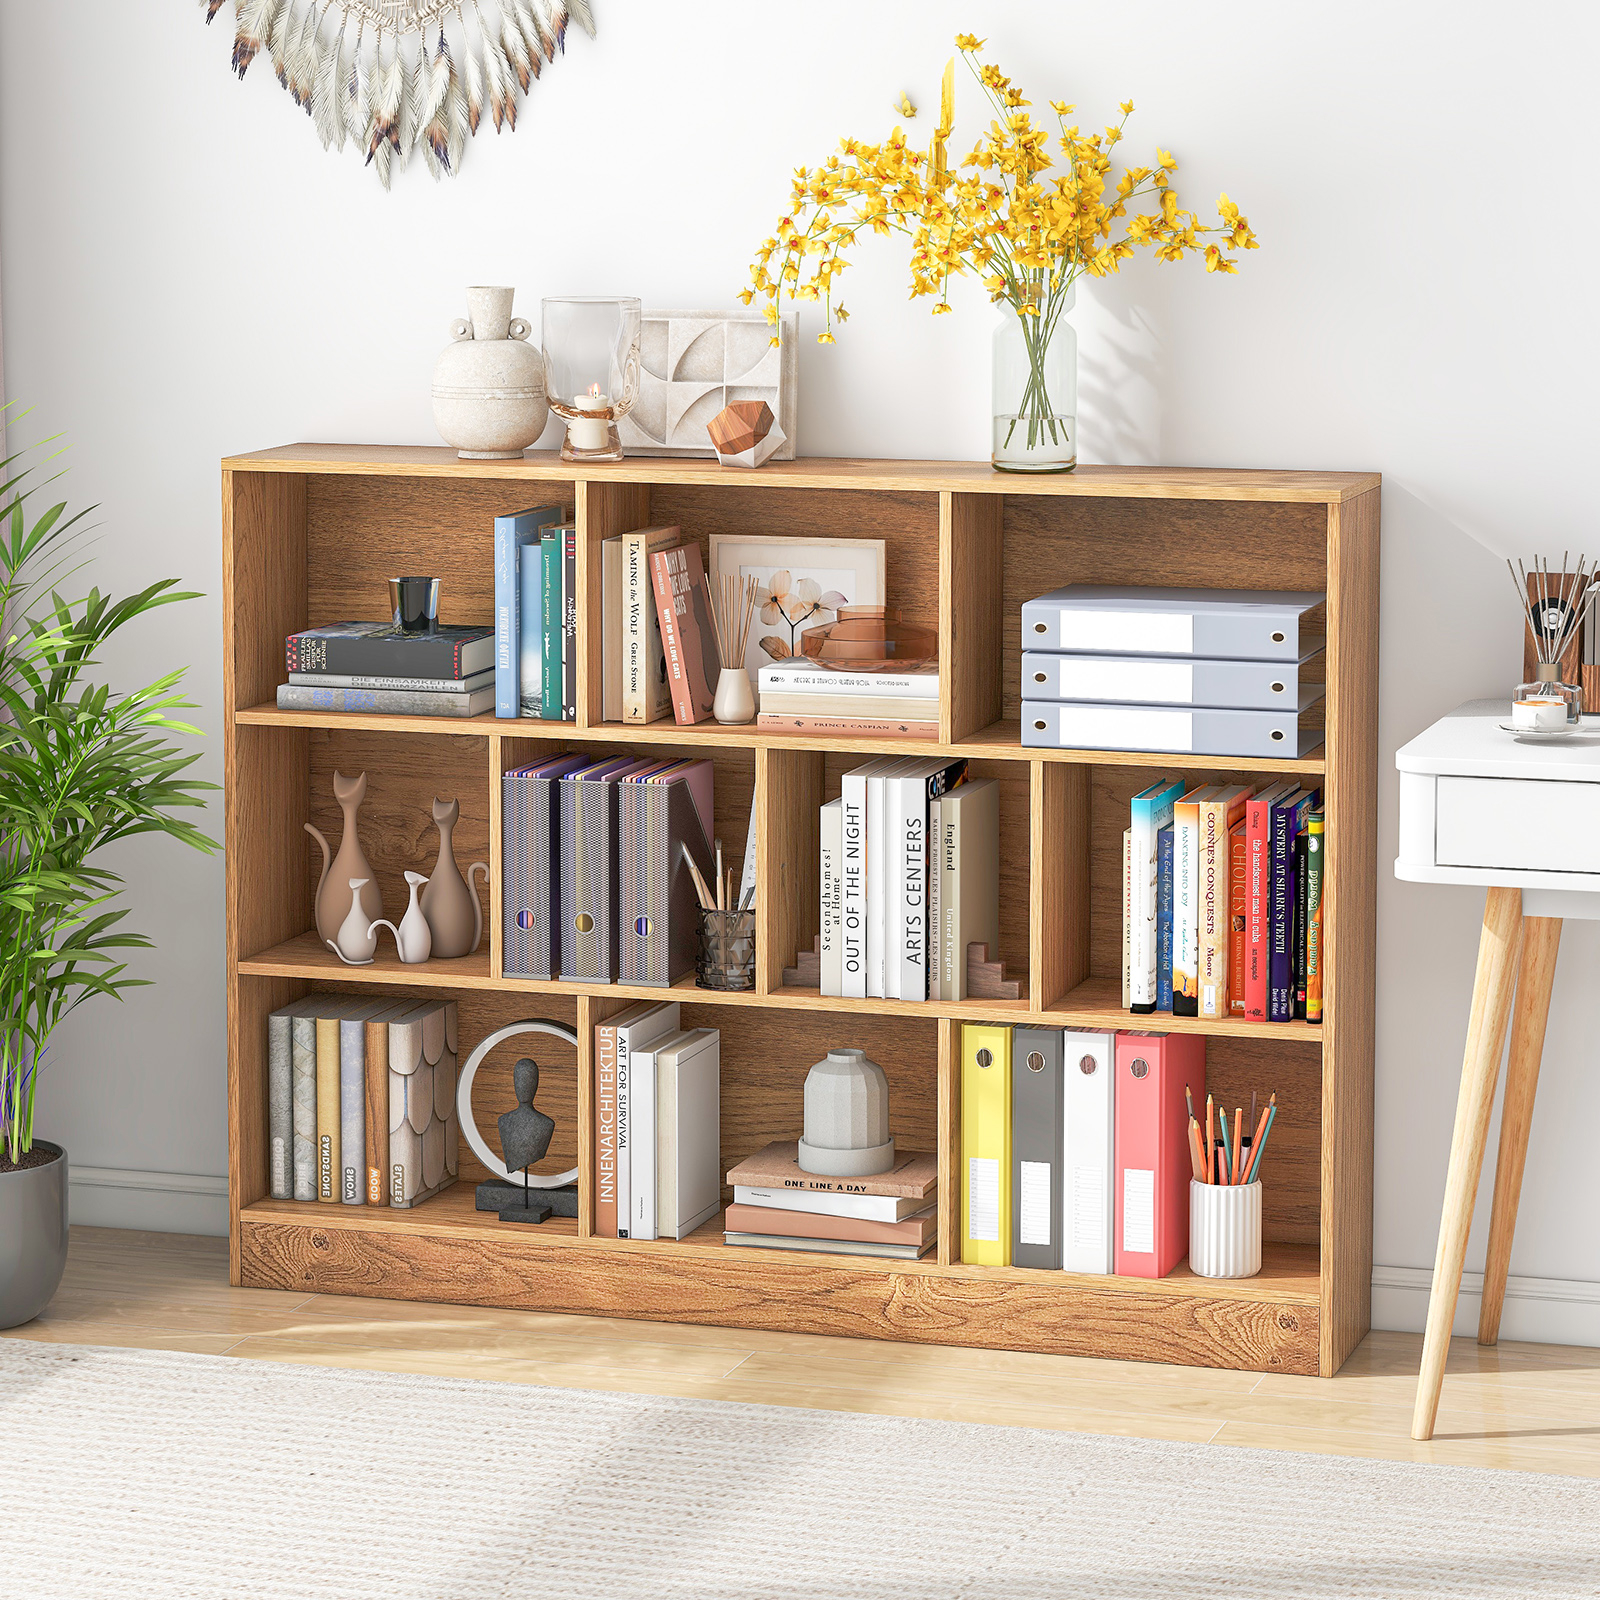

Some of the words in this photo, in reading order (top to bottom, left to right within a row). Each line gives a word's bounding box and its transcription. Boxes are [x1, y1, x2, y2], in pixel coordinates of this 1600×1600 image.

[630, 540, 640, 586] TAMING
[630, 589, 638, 601] the
[630, 603, 640, 636] WOLF
[663, 608, 672, 624] WHY
[665, 624, 674, 634] DO
[667, 634, 676, 646] WE
[669, 645, 679, 662] LOVE
[630, 642, 639, 666] GREG
[374, 678, 448, 686] EINSAMKEIT
[630, 667, 639, 694] STONE
[672, 662, 681, 680] CATS
[379, 683, 458, 691] PRIMZAHLEN
[928, 769, 946, 800] CORE
[846, 803, 860, 859] NIGHT
[1164, 839, 1171, 847] At
[1206, 812, 1216, 864] CONNIE'S
[1276, 814, 1286, 861] MYSTERY
[945, 823, 956, 872] England
[1163, 849, 1171, 859] the
[1252, 839, 1262, 852] the
[906, 817, 922, 906] CENTERS
[1163, 860, 1171, 875] End
[1252, 853, 1262, 896] handsomest
[1276, 863, 1285, 875] AT
[846, 866, 860, 899] THE
[1162, 875, 1171, 883] of
[1163, 883, 1171, 894] the
[1232, 843, 1247, 913] CHOICES
[1308, 870, 1318, 911] World
[822, 848, 831, 951] Secondhomes!
[832, 877, 841, 911] Home
[1162, 894, 1171, 912] Ages
[1181, 891, 1189, 907] JOY
[1205, 869, 1216, 935] CONQUESTS
[1275, 877, 1285, 920] SHARK'S
[833, 914, 841, 925] at
[846, 906, 860, 929] OF
[945, 908, 953, 943] United
[1252, 916, 1261, 924] in
[906, 915, 922, 965] ARTS
[1252, 925, 1261, 943] cuba
[1275, 922, 1285, 954] TEETH
[846, 938, 860, 973] OUT
[1308, 920, 1319, 976] Fantasy
[945, 943, 954, 982] Kingdom
[1206, 947, 1215, 977] Moore
[618, 1036, 627, 1060] ART
[618, 1064, 627, 1090] FOR
[600, 1026, 614, 1203] INNENARCHITEKTUR
[618, 1094, 627, 1150] SURVIVAL
[784, 1179, 805, 1188] ONE
[809, 1182, 833, 1190] LINE
[846, 1185, 867, 1193] DAY
